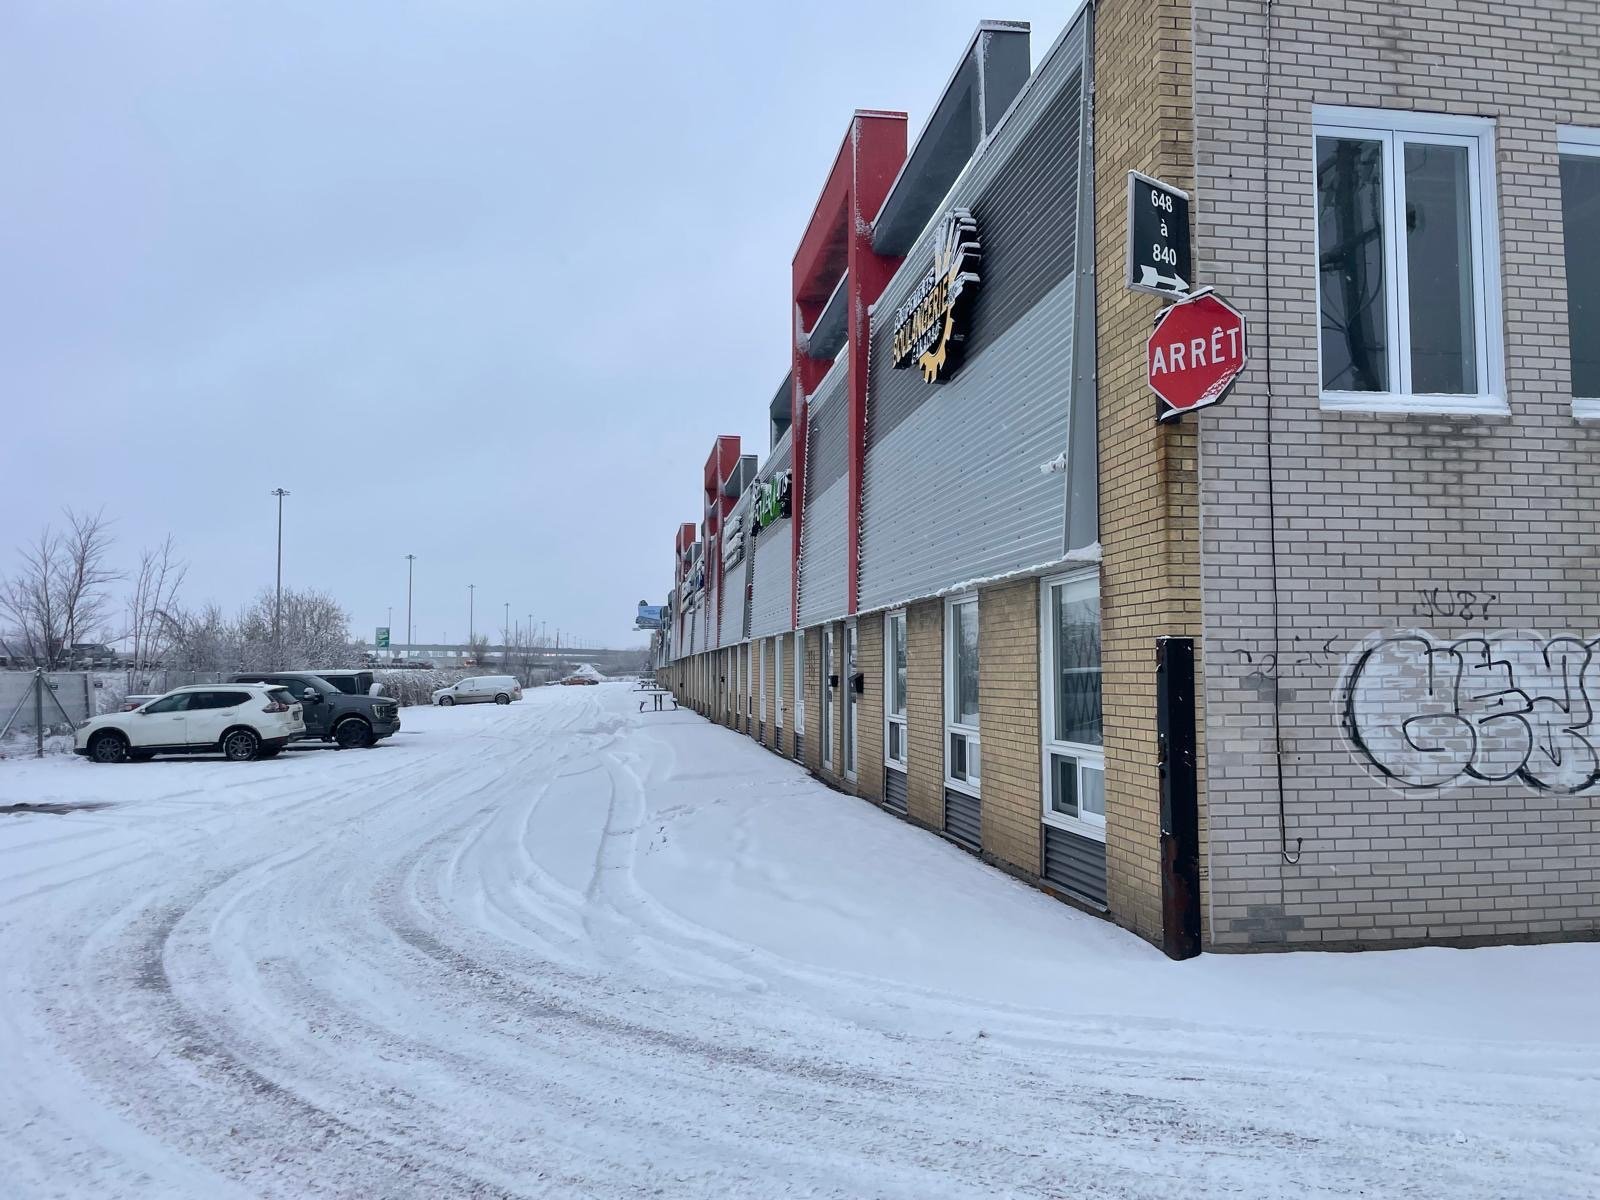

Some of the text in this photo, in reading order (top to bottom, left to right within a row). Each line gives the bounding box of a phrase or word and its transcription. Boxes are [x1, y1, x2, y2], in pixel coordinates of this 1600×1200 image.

[1151, 189, 1173, 214] 648
[1160, 219, 1169, 238] à
[1152, 243, 1177, 266] 840
[1151, 326, 1240, 376] ARRÊT
